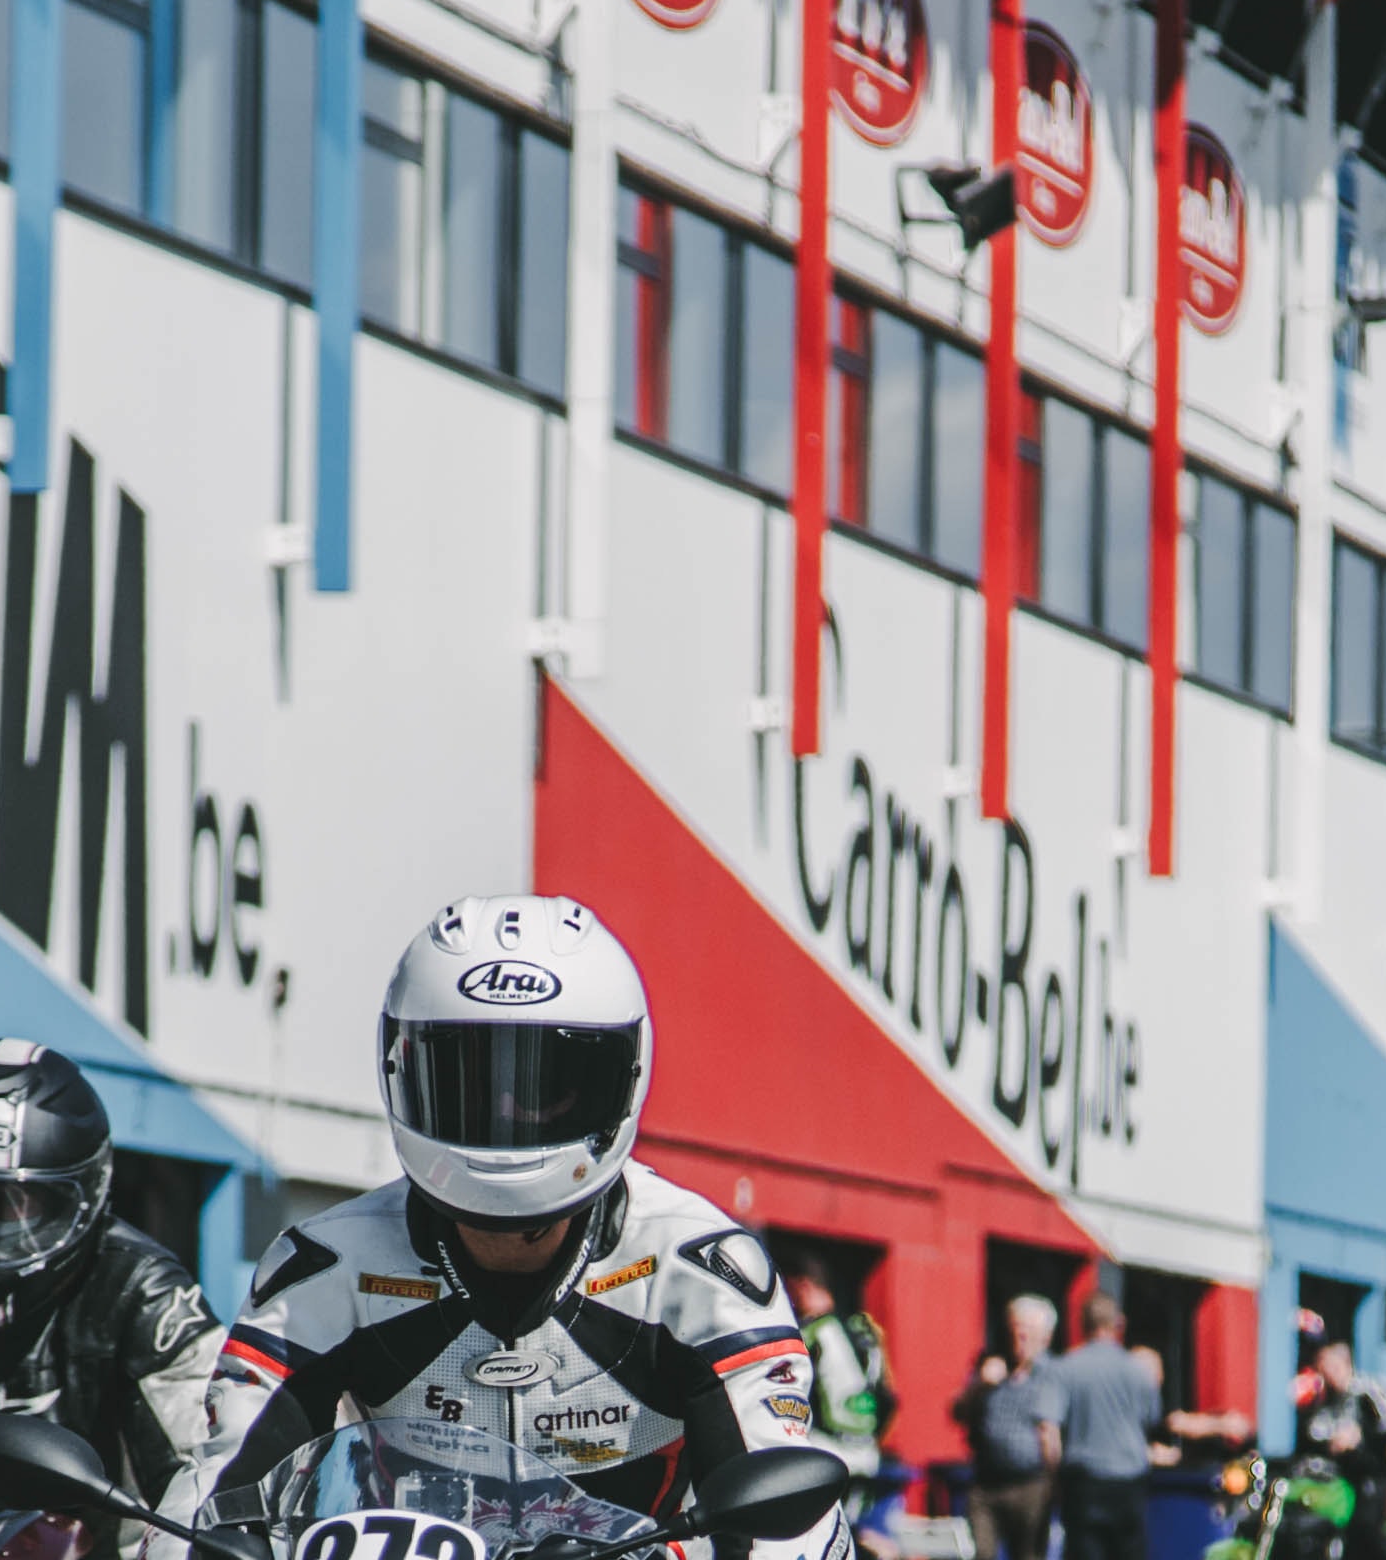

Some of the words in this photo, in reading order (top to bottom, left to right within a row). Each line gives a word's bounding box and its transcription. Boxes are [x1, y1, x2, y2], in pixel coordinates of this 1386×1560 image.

[467, 964, 549, 993] Arai
[555, 1238, 590, 1302] DAMEN
[482, 1362, 534, 1375] DAMEN
[534, 1403, 631, 1433] artinar
